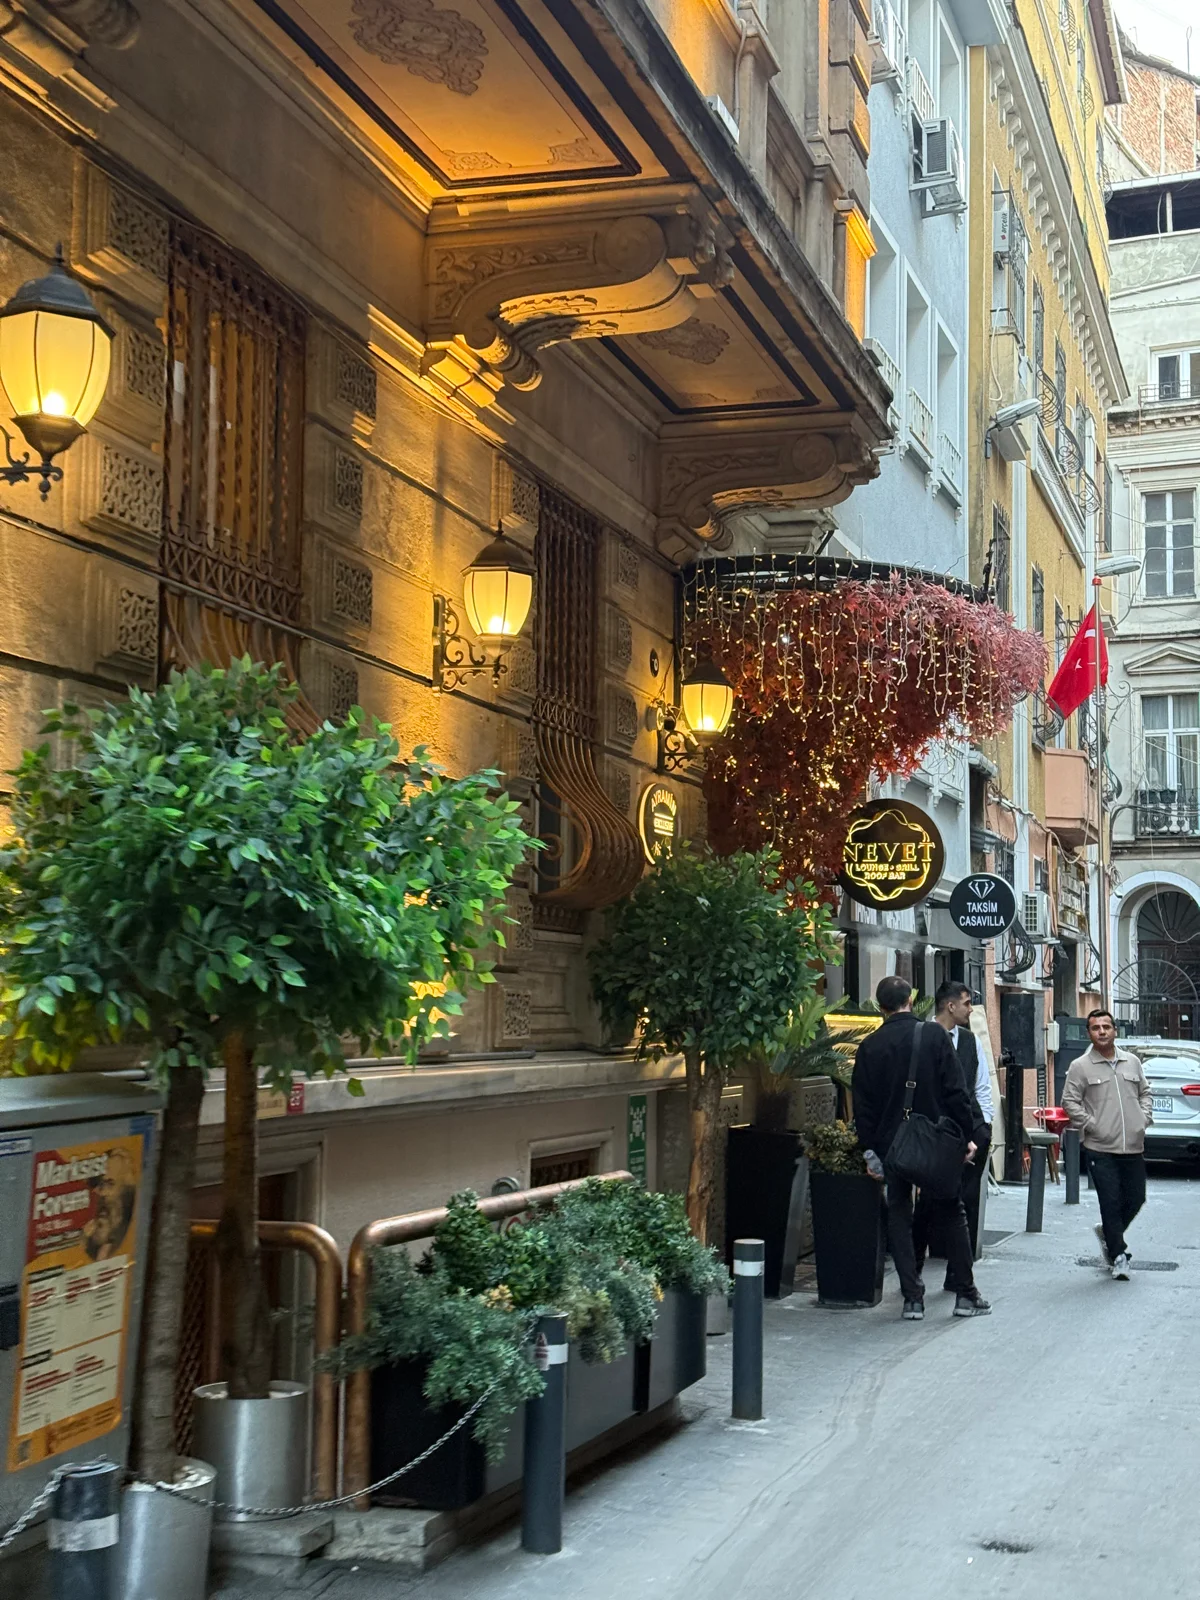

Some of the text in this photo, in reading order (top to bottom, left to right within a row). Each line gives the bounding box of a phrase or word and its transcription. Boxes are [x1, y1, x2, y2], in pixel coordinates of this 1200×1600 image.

[842, 842, 936, 863] NEVET
[855, 863, 920, 872] LOUNGE GRILL
[864, 872, 906, 880] ROOF BAR
[966, 900, 998, 913] TAKSİM
[959, 915, 1006, 927] CASAVILLA
[36, 1152, 109, 1189] Marksist
[32, 1188, 91, 1220] Forum
